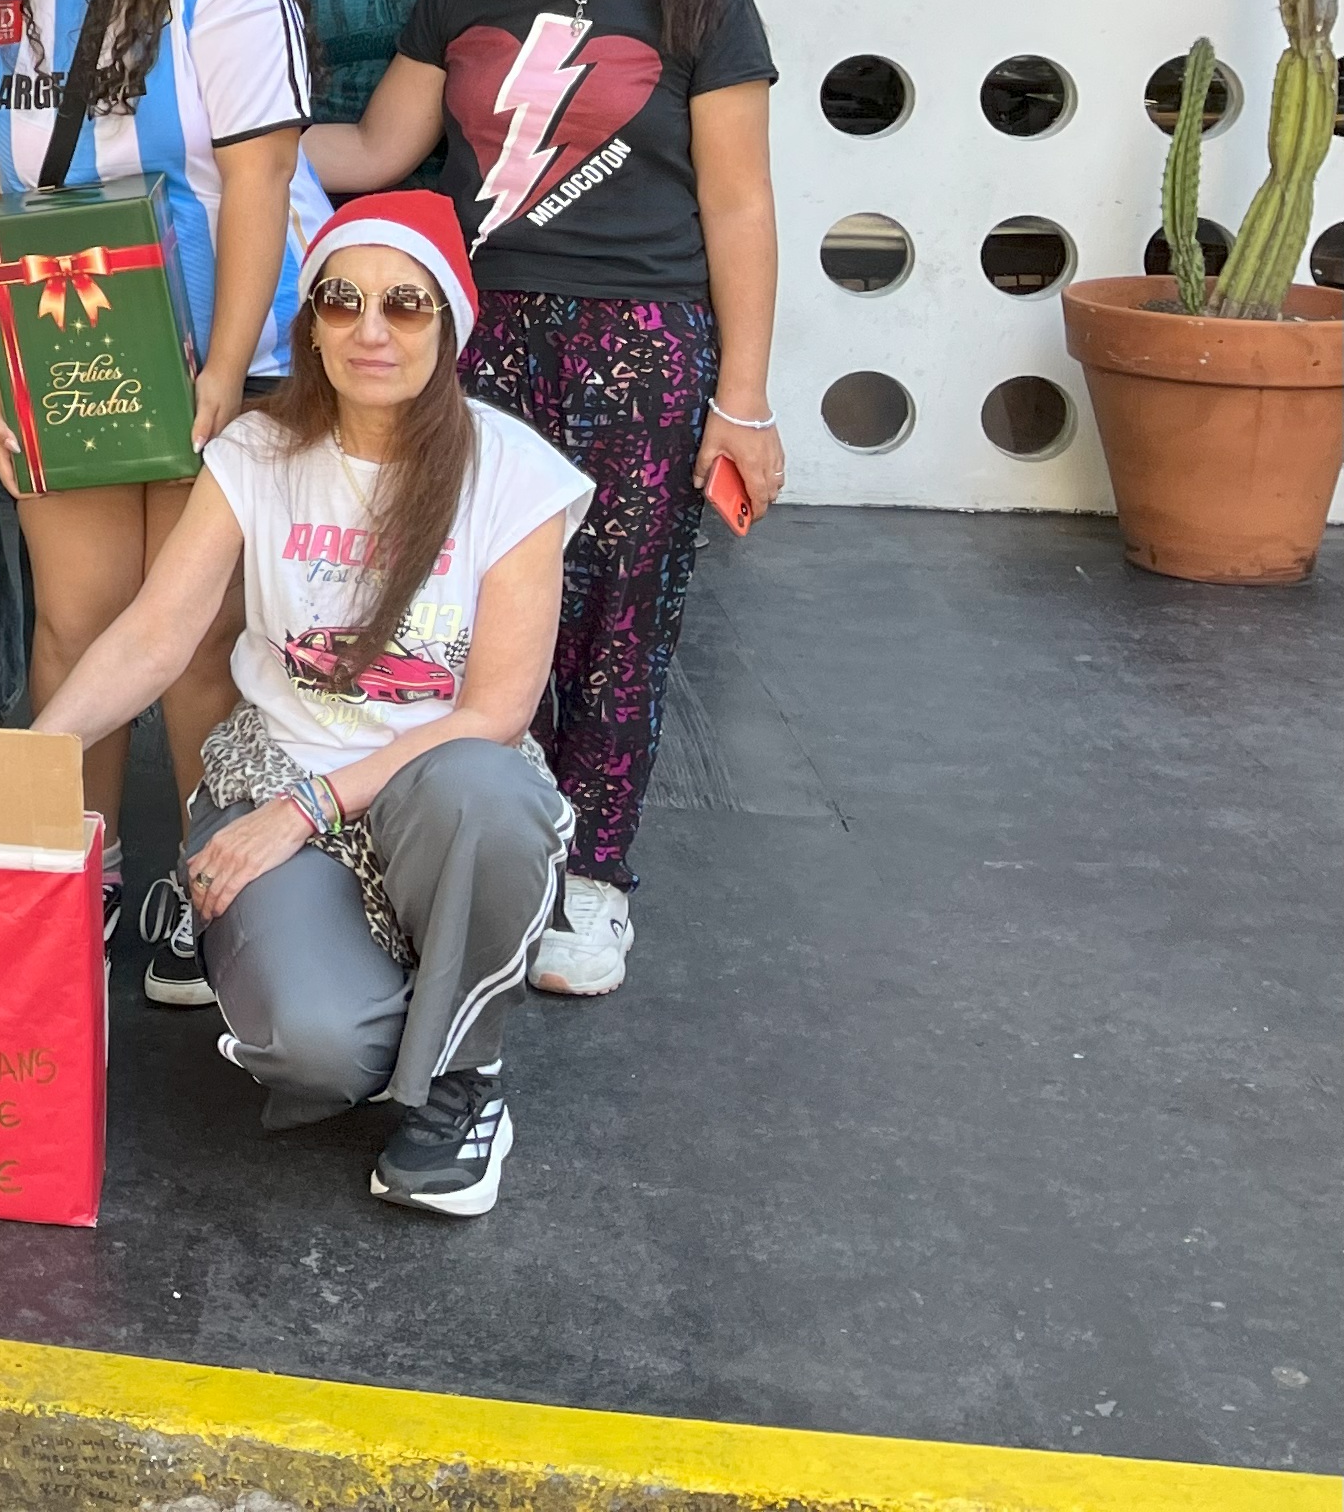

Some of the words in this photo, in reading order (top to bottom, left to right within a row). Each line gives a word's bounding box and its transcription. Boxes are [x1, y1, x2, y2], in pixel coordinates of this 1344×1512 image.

[526, 138, 632, 227] MELOCOTON
[50, 353, 124, 389] Felices
[42, 379, 143, 425] Fiestas
[307, 558, 349, 583] Fast
[408, 602, 463, 642] 93
